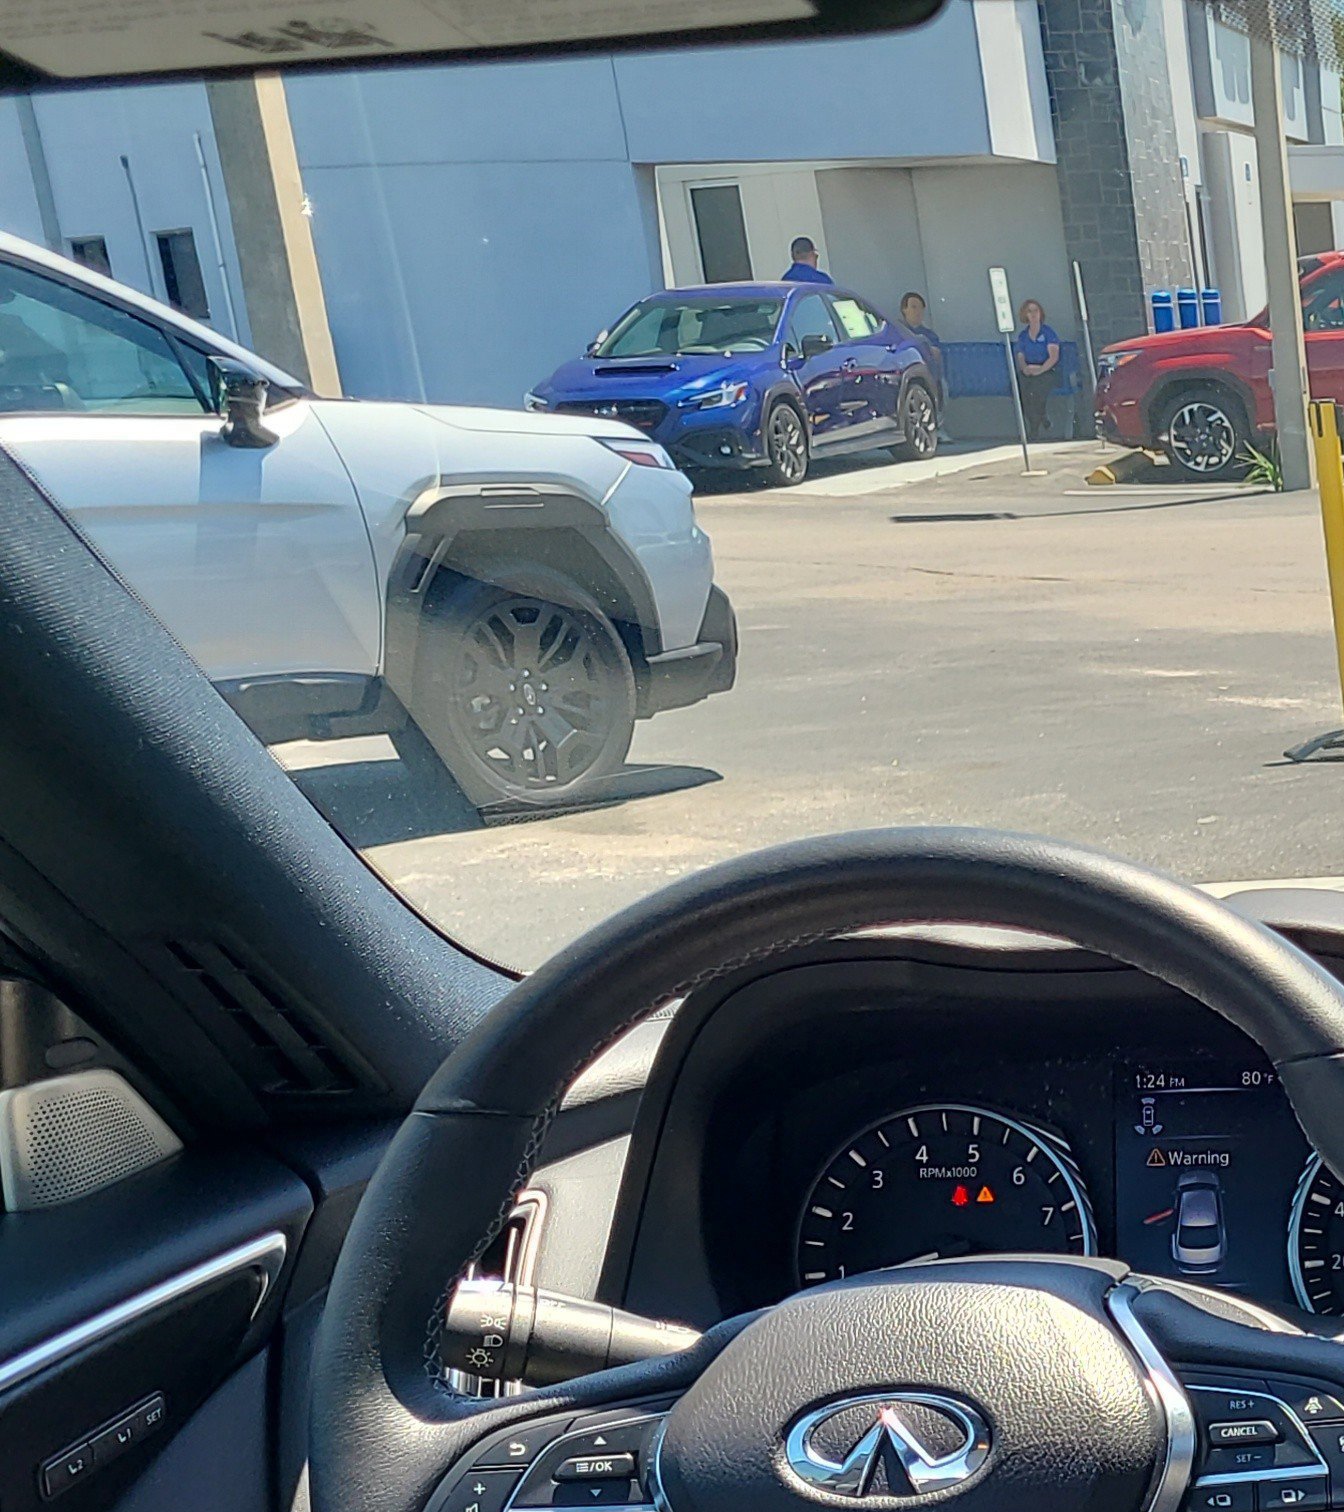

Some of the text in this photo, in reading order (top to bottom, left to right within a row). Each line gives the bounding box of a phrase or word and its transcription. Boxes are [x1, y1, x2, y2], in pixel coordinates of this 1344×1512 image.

[1136, 1074, 1185, 1089] 1:24 PM
[1242, 1071, 1261, 1085] 80
[915, 1145, 928, 1163] 4
[968, 1144, 980, 1162] 5
[1168, 1151, 1230, 1166] Warning
[872, 1171, 884, 1189] 3
[919, 1167, 977, 1178] RPMx1000
[1012, 1167, 1025, 1185] 6
[842, 1212, 853, 1230] 2
[1042, 1207, 1054, 1225] 7
[838, 1265, 844, 1279] 1
[145, 1407, 162, 1425] SET
[1221, 1427, 1258, 1437] CANCEL
